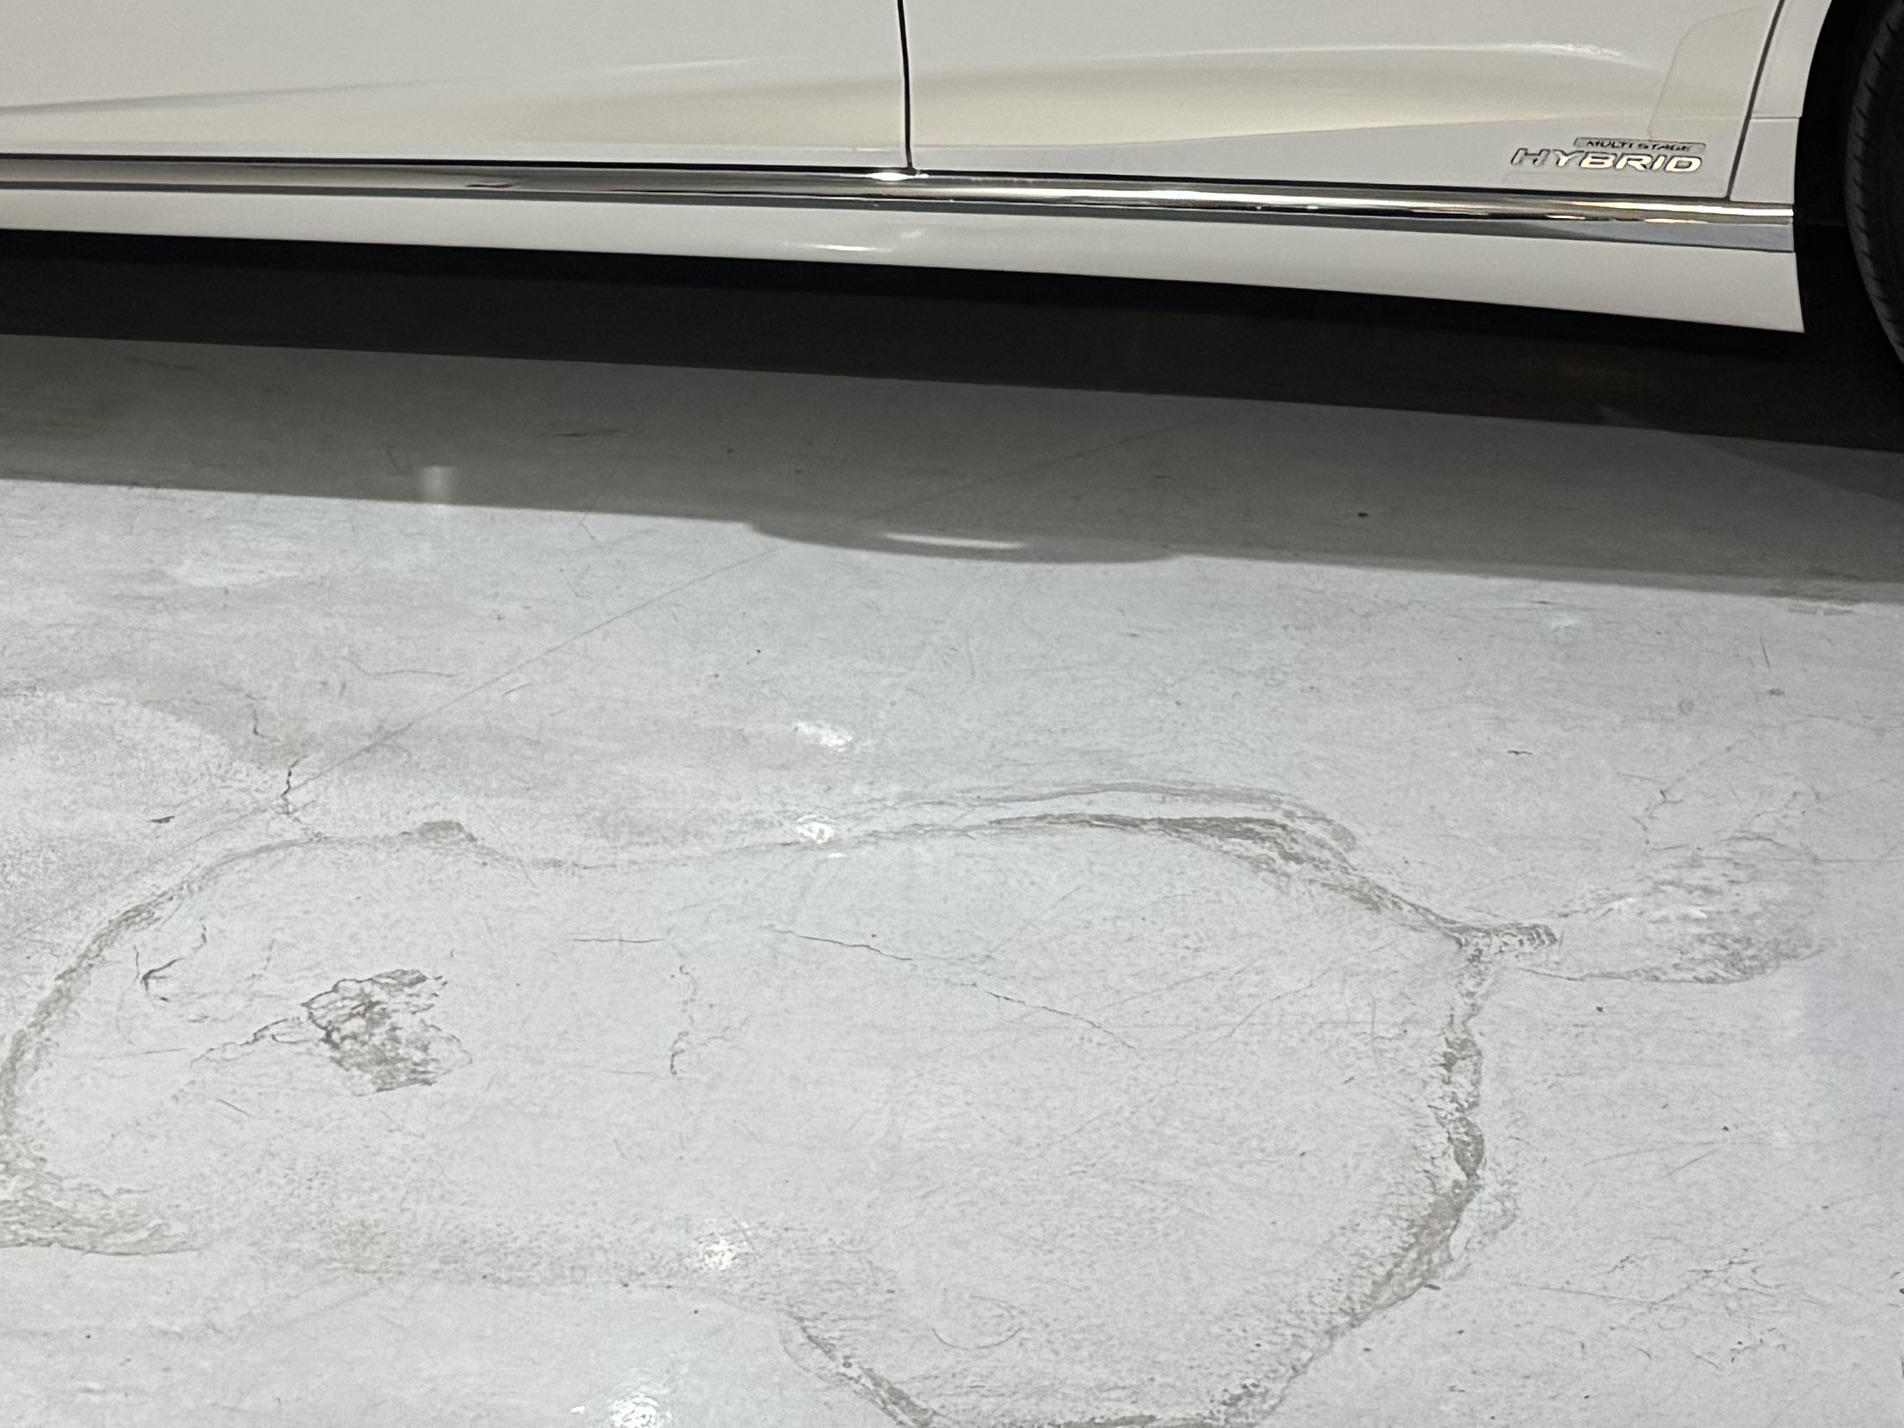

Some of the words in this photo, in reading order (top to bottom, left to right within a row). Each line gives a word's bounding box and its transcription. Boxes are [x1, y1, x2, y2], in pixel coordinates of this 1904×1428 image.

[1586, 139, 1634, 150] MULTI
[1637, 142, 1693, 152] STAGE
[1510, 147, 1703, 174] HYBRID
